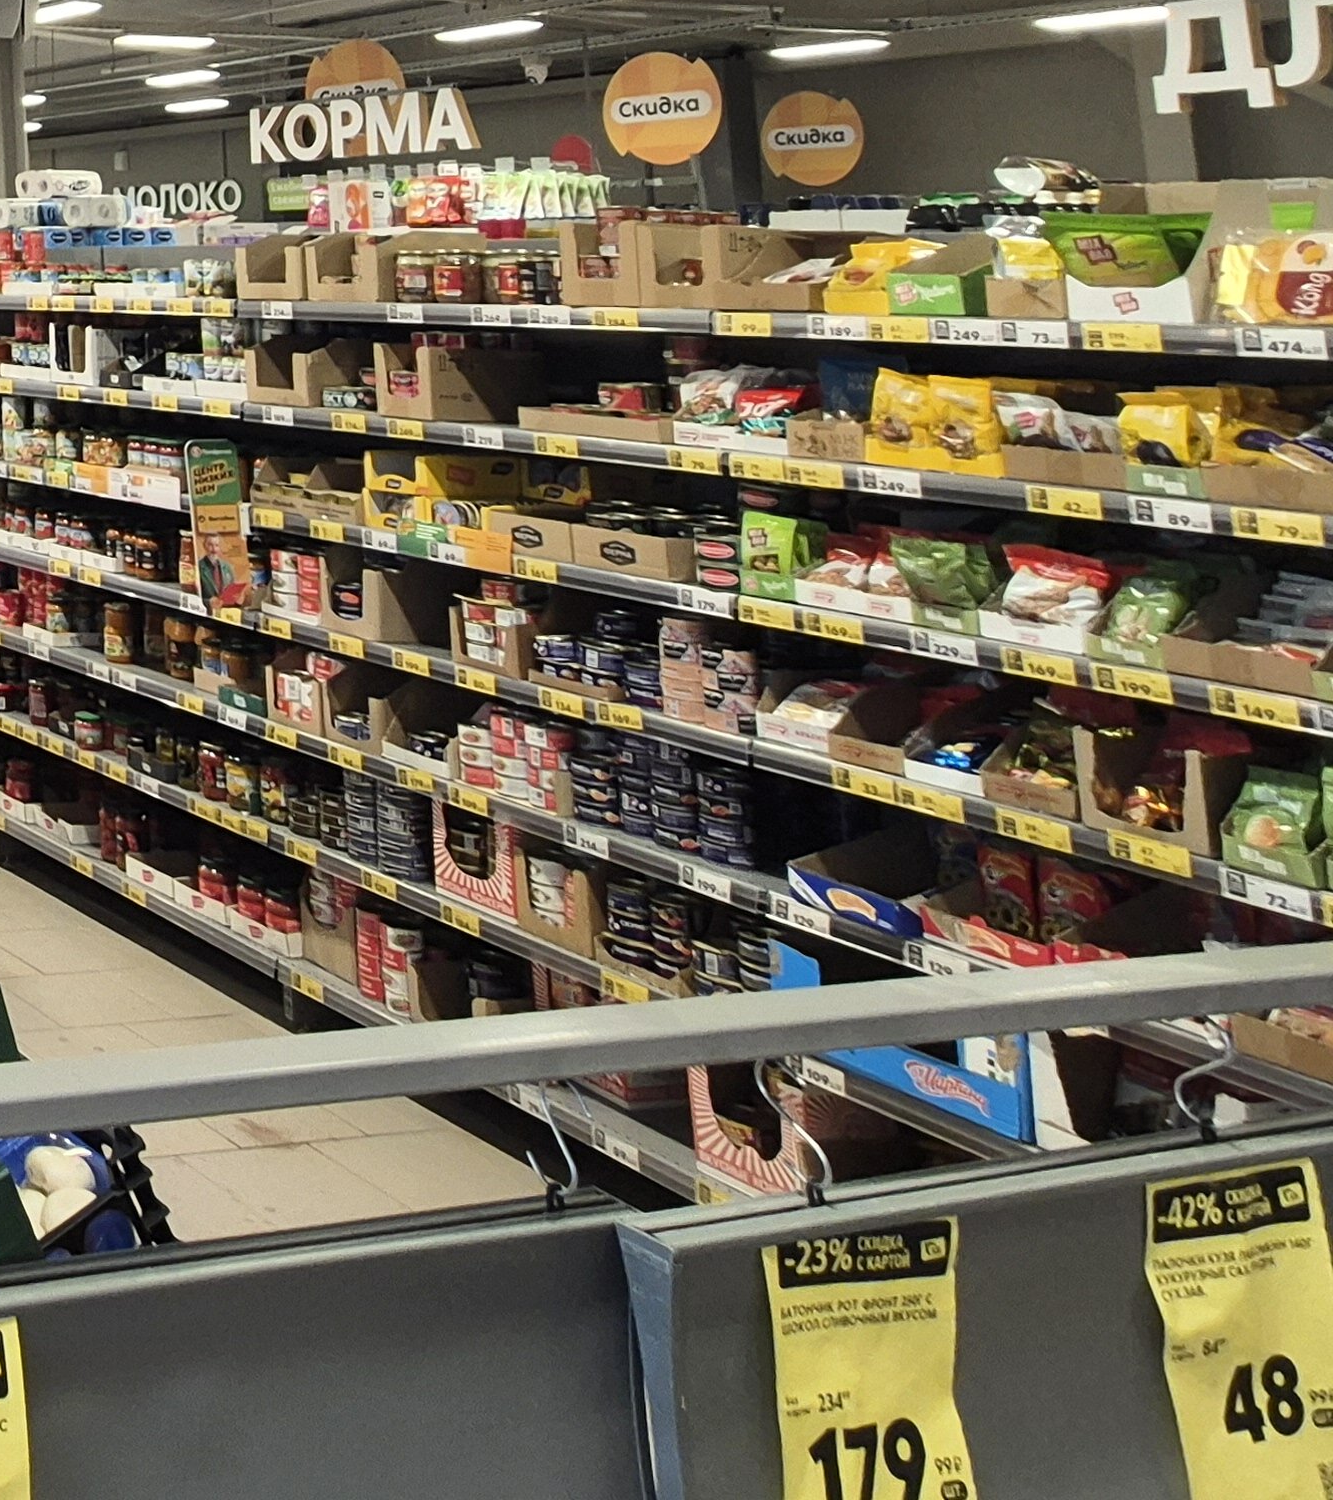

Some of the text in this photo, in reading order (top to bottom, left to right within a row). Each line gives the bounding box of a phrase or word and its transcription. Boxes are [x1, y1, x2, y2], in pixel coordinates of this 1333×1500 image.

[618, 96, 700, 118] Скидка
[249, 87, 475, 165] КОРМА
[774, 128, 845, 146] Скидка
[829, 326, 852, 337] 189
[953, 330, 980, 341] 249
[1031, 332, 1049, 344] 73
[1268, 341, 1303, 354] 474
[193, 462, 225, 477] ЦЕНТР
[193, 470, 235, 486] НИЗКИХ
[195, 484, 215, 495] ЦЕН
[879, 481, 904, 492] 249
[1063, 502, 1082, 513] 42
[1168, 514, 1191, 526] 89
[1275, 526, 1299, 539] 79
[824, 624, 848, 637] 169
[933, 643, 959, 658] 229
[1027, 663, 1057, 678] 169
[1120, 681, 1151, 696] 199
[1242, 703, 1276, 721] 149
[696, 878, 717, 893] 199
[1264, 892, 1287, 909] 72
[793, 914, 813, 928] 129
[928, 960, 953, 974] 129
[807, 1069, 830, 1085] 109
[1157, 1191, 1223, 1229] -42%
[857, 1233, 904, 1251] СКИДКА
[784, 1238, 853, 1275] -23%
[857, 1249, 911, 1271] С КАРТОЙ
[837, 1298, 859, 1311] РОТ
[1224, 1354, 1305, 1444] 48
[808, 1417, 926, 1500] 179
